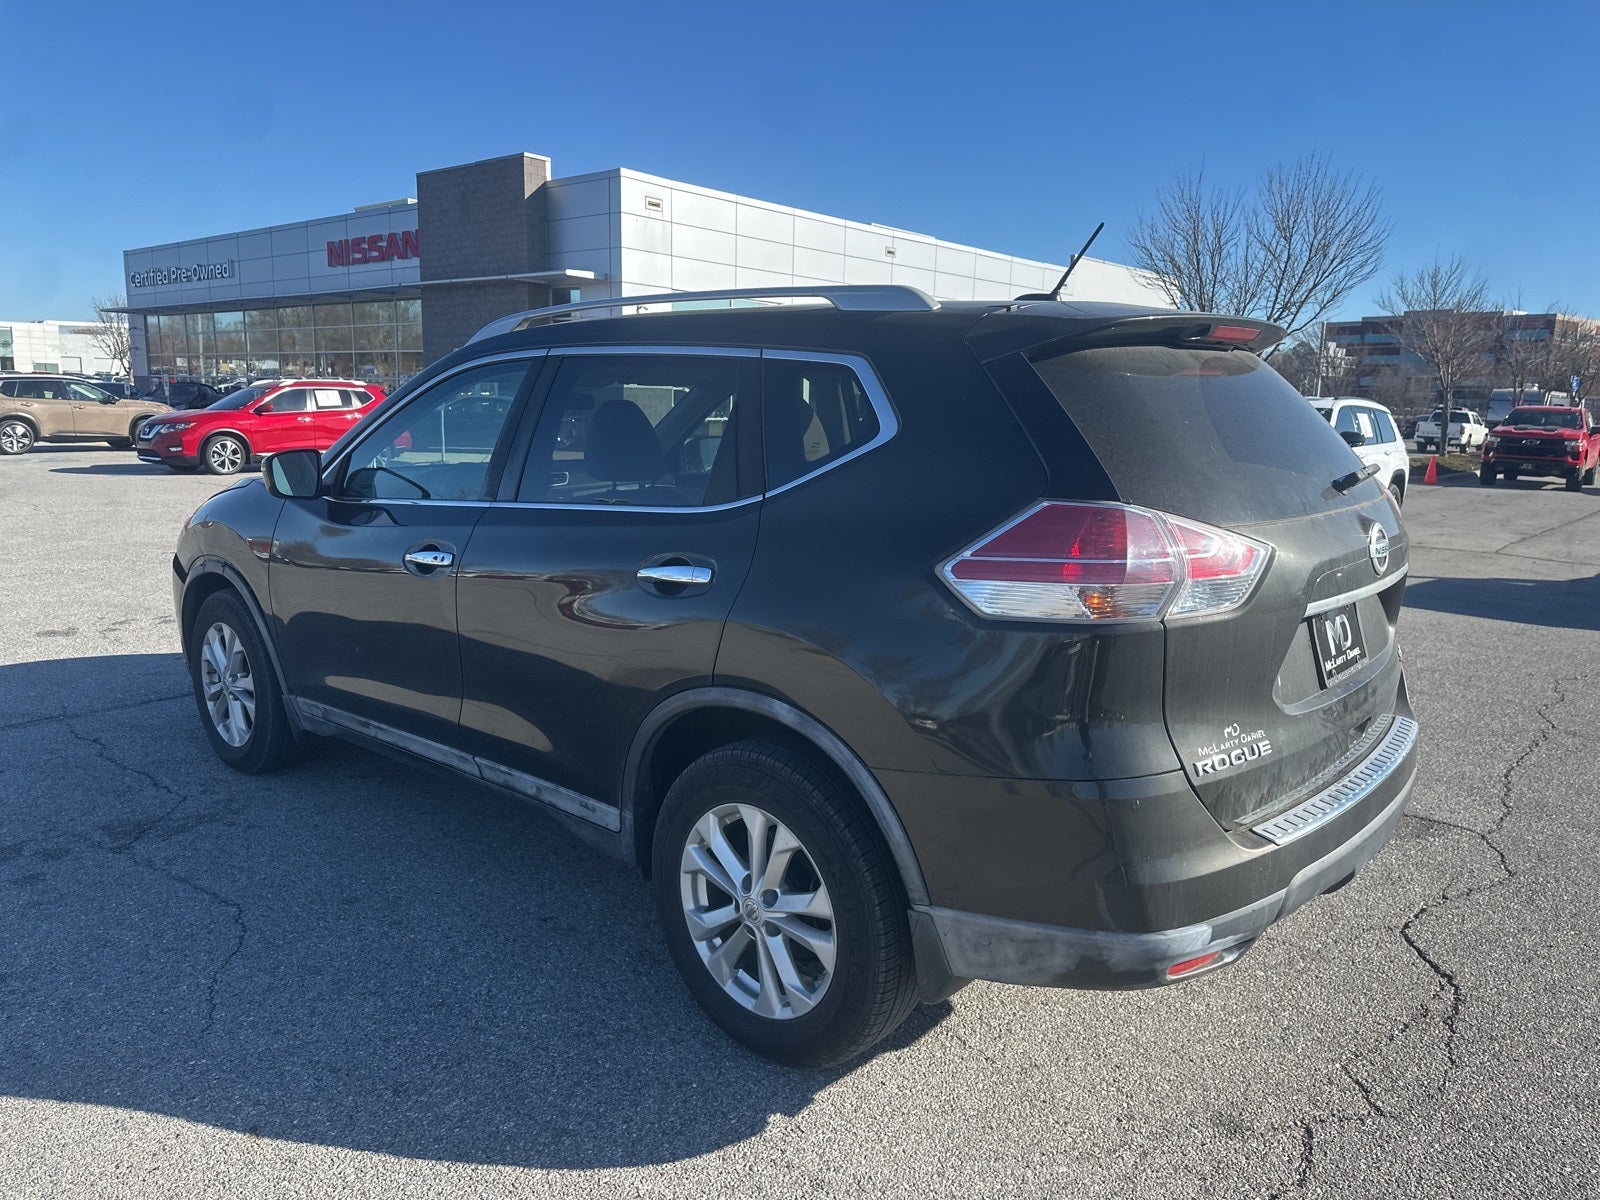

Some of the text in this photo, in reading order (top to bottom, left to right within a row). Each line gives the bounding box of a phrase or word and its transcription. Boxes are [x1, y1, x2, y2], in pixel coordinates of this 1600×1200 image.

[327, 229, 419, 267] NISSAN
[130, 259, 232, 287] Certified Pre-Owned
[1194, 740, 1273, 777] ROGUE
